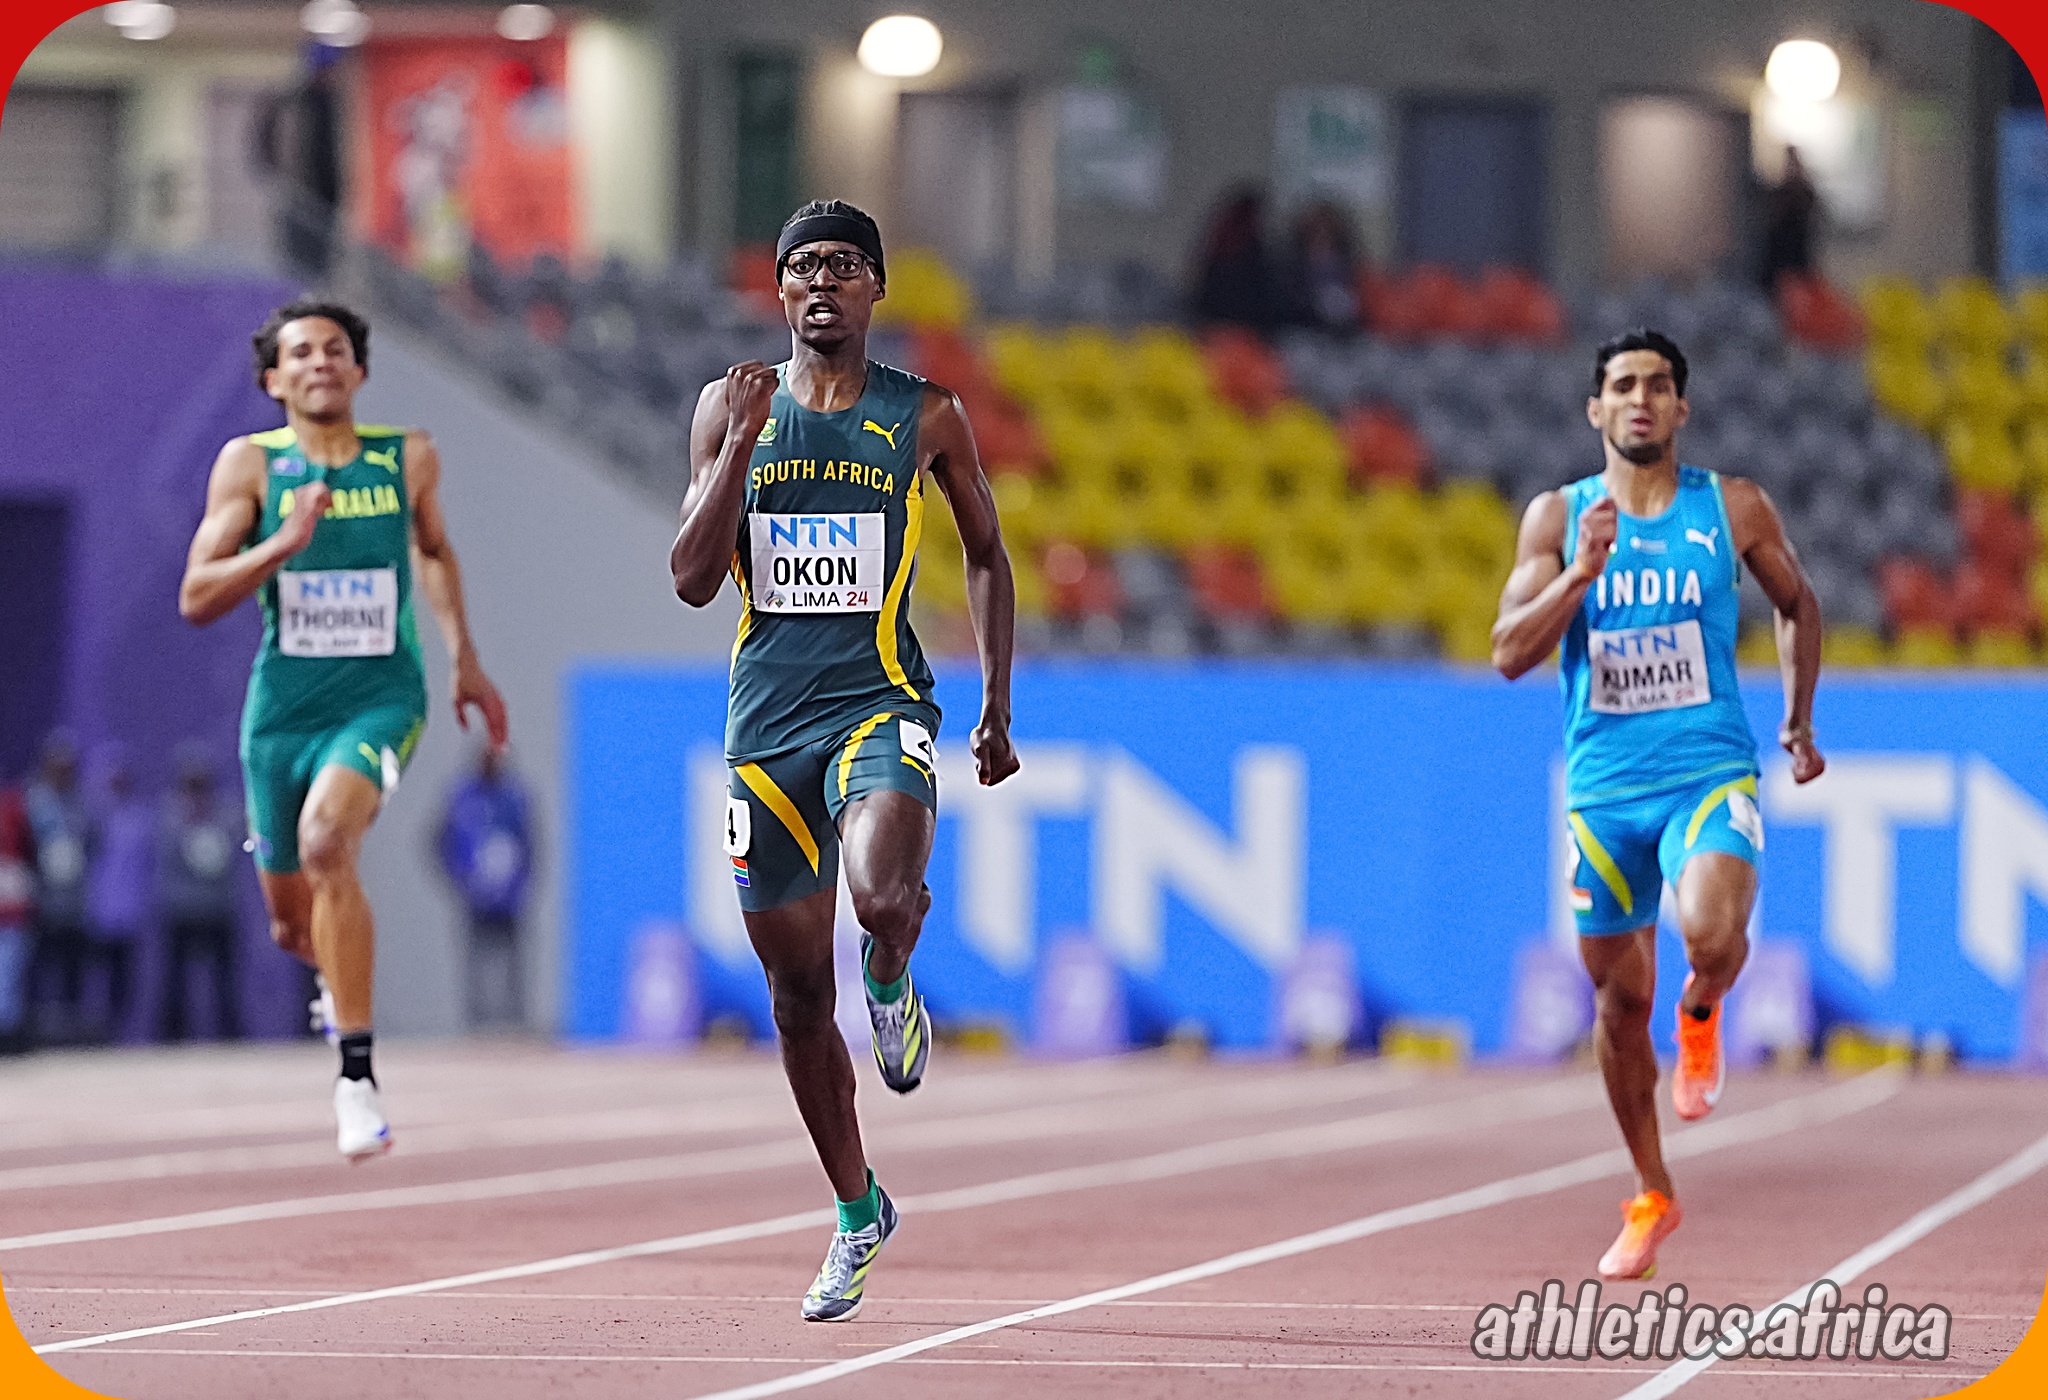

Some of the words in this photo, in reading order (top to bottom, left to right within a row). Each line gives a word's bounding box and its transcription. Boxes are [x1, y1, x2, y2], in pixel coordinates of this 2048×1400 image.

[752, 459, 815, 490] SOUTH
[823, 461, 894, 497] AFRICA
[278, 484, 401, 519] ARALIA
[770, 516, 858, 548] NTN
[302, 574, 374, 597] NTN
[773, 557, 857, 586] OKON
[792, 591, 840, 607] LIMA
[846, 591, 869, 607] 24
[1597, 566, 1702, 611] INDIA
[1603, 624, 1677, 658] NTN
[1601, 659, 1692, 691] KUMAR
